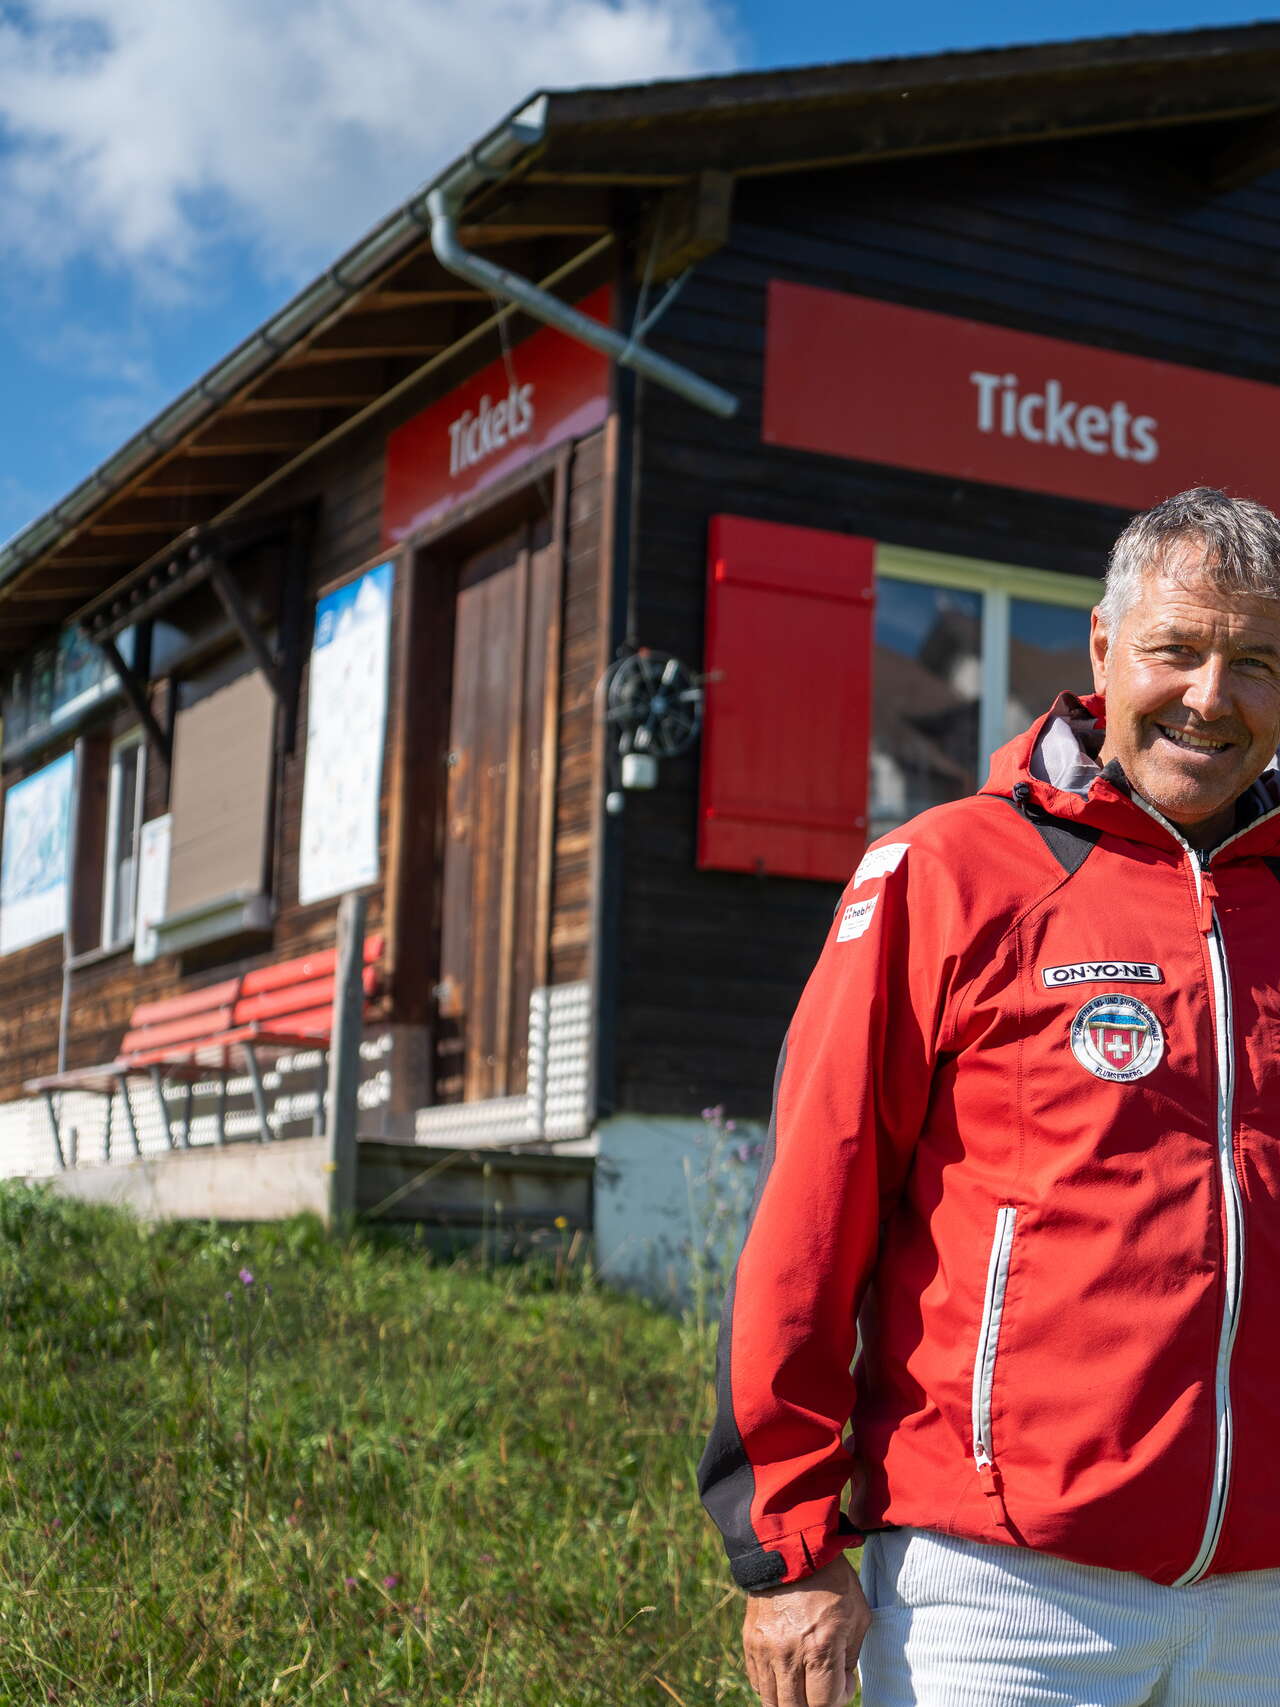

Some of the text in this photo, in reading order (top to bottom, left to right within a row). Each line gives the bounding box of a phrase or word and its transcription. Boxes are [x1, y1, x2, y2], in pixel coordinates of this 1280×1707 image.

[447, 383, 535, 478] Tickets
[970, 371, 1159, 464] Tickets
[1105, 997, 1119, 1005] UND
[1095, 1066, 1143, 1080] FLUMSERBERG
